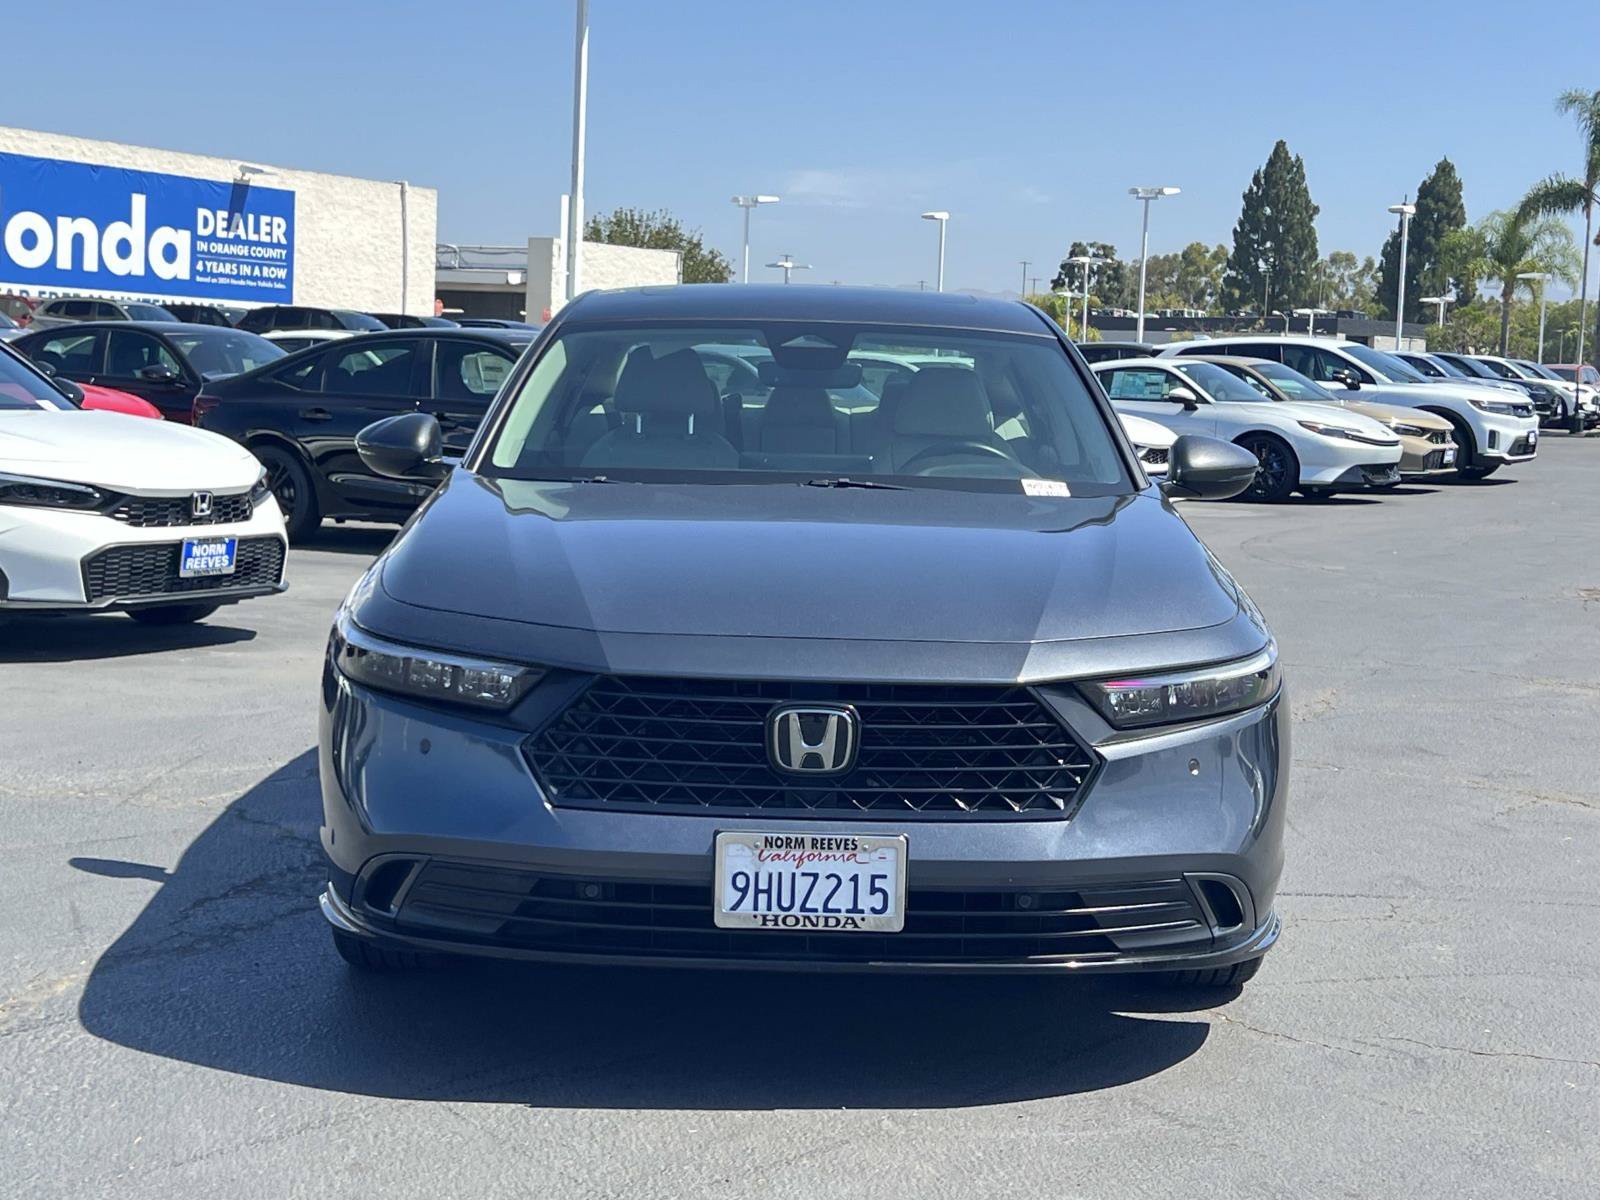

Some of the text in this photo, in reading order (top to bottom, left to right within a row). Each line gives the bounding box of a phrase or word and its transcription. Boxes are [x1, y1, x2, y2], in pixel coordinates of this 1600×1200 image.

[197, 208, 287, 244] DEALER
[4, 193, 192, 280] onda
[197, 241, 287, 260] IN ORANGE COUNTY
[196, 261, 287, 279] 4 YEARS IN A ROW
[192, 543, 227, 557] NORM
[185, 555, 230, 570] REEVES
[764, 836, 858, 850] NORM REEVES
[757, 848, 870, 869] California
[729, 871, 889, 915] 9HUZ215
[759, 914, 862, 929] HONDA
